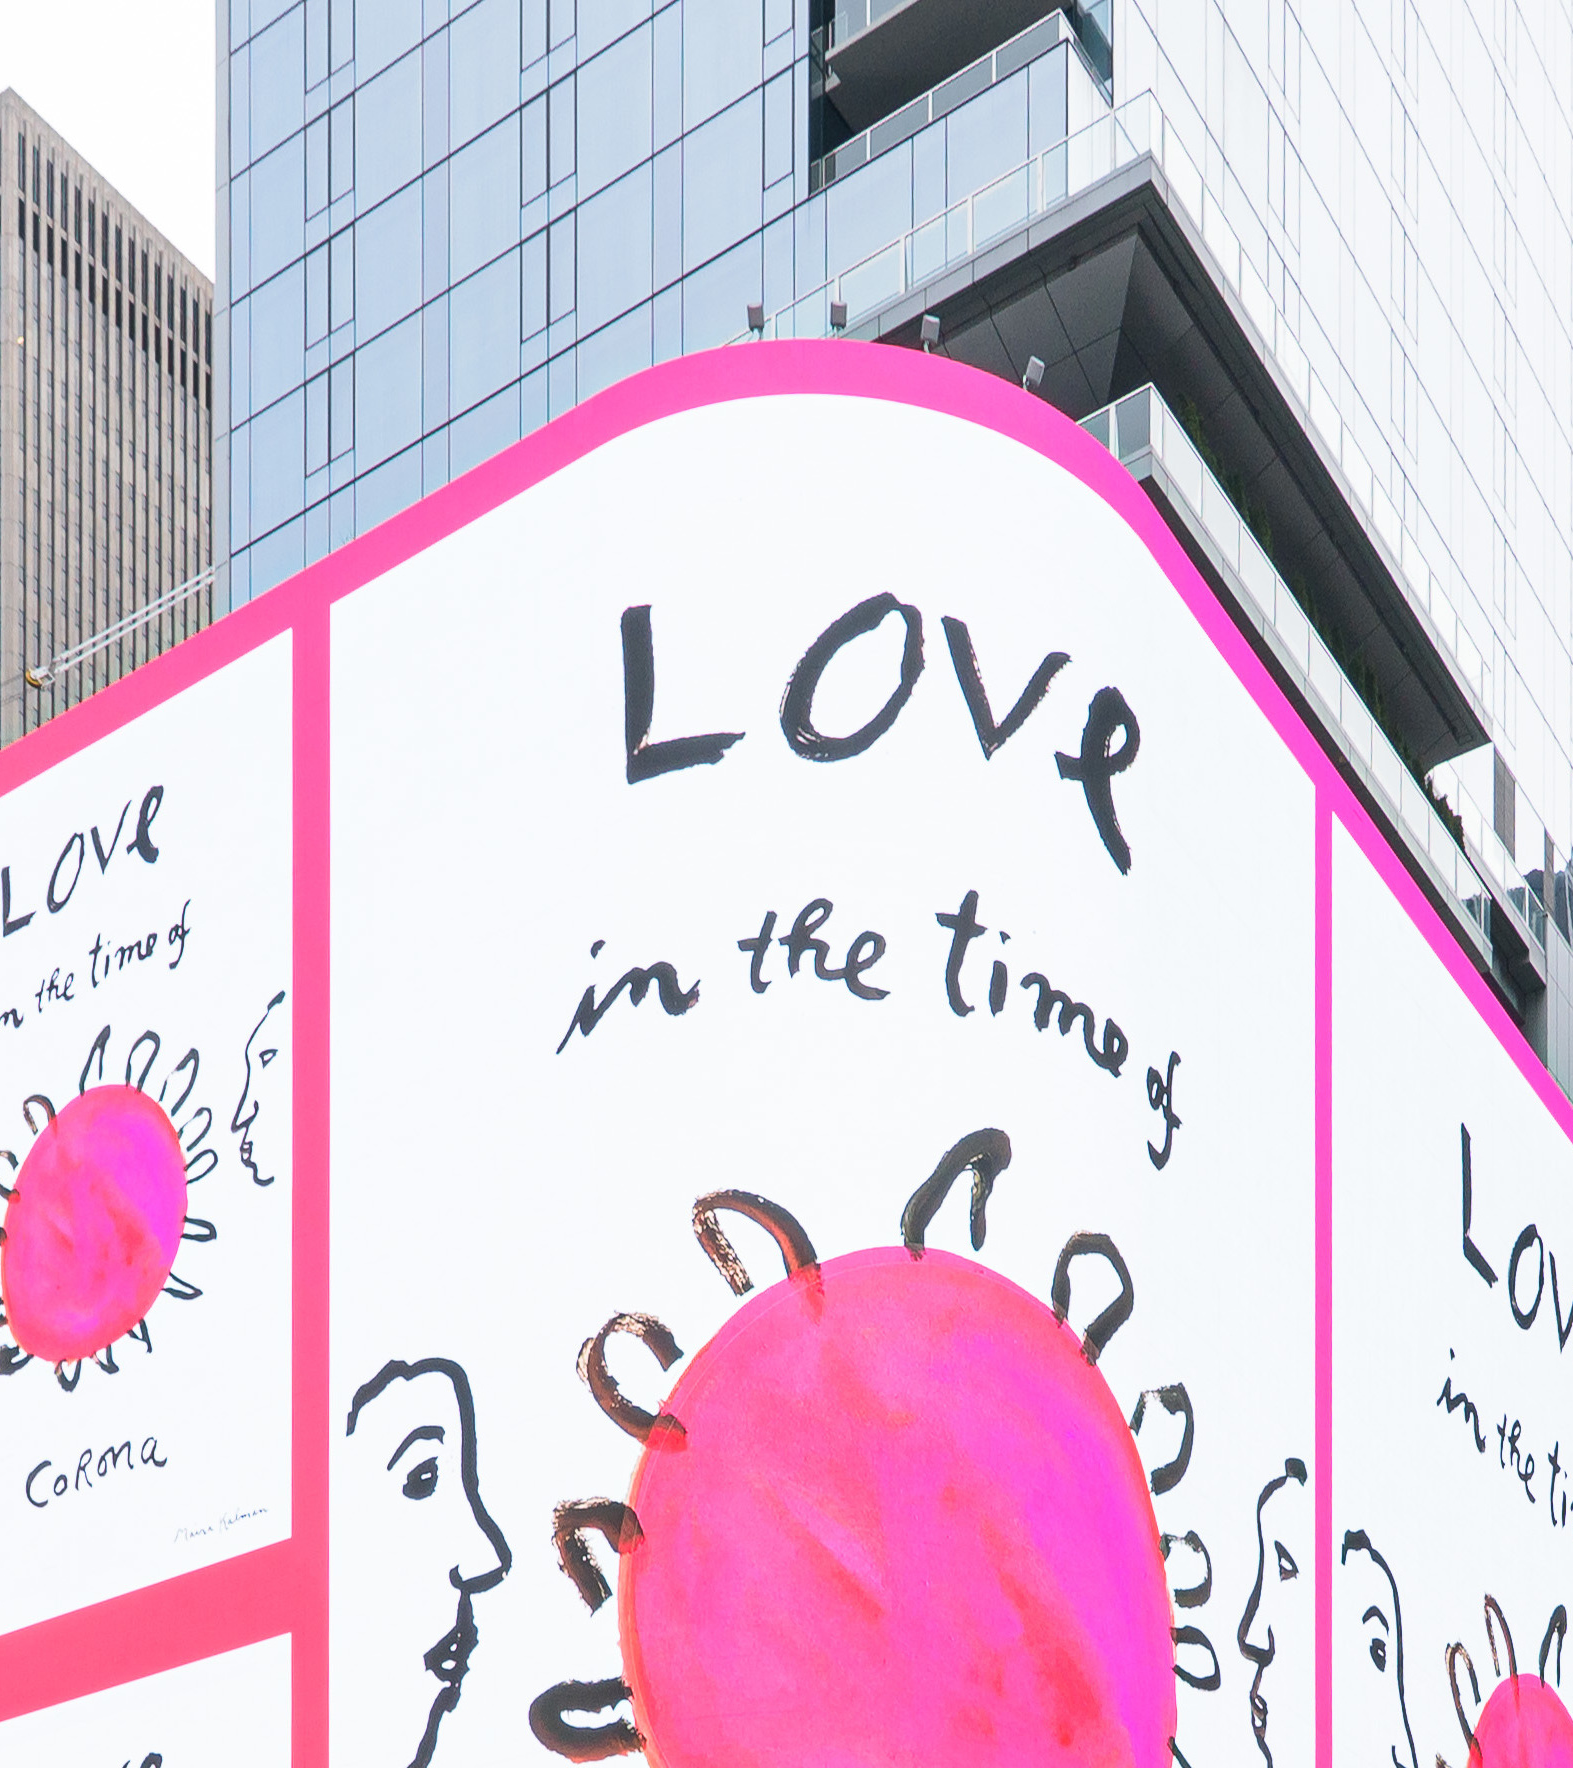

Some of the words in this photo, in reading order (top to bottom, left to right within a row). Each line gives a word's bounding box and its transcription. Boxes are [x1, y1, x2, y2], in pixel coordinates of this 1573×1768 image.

[36, 968, 74, 1012] the
[89, 934, 157, 988] time
[169, 900, 190, 969] of
[557, 940, 700, 1054] in
[738, 899, 890, 1000] the
[936, 891, 1128, 1078] time
[1147, 1051, 1182, 1170] of
[1437, 1349, 1486, 1452] in
[1497, 1415, 1535, 1503] the
